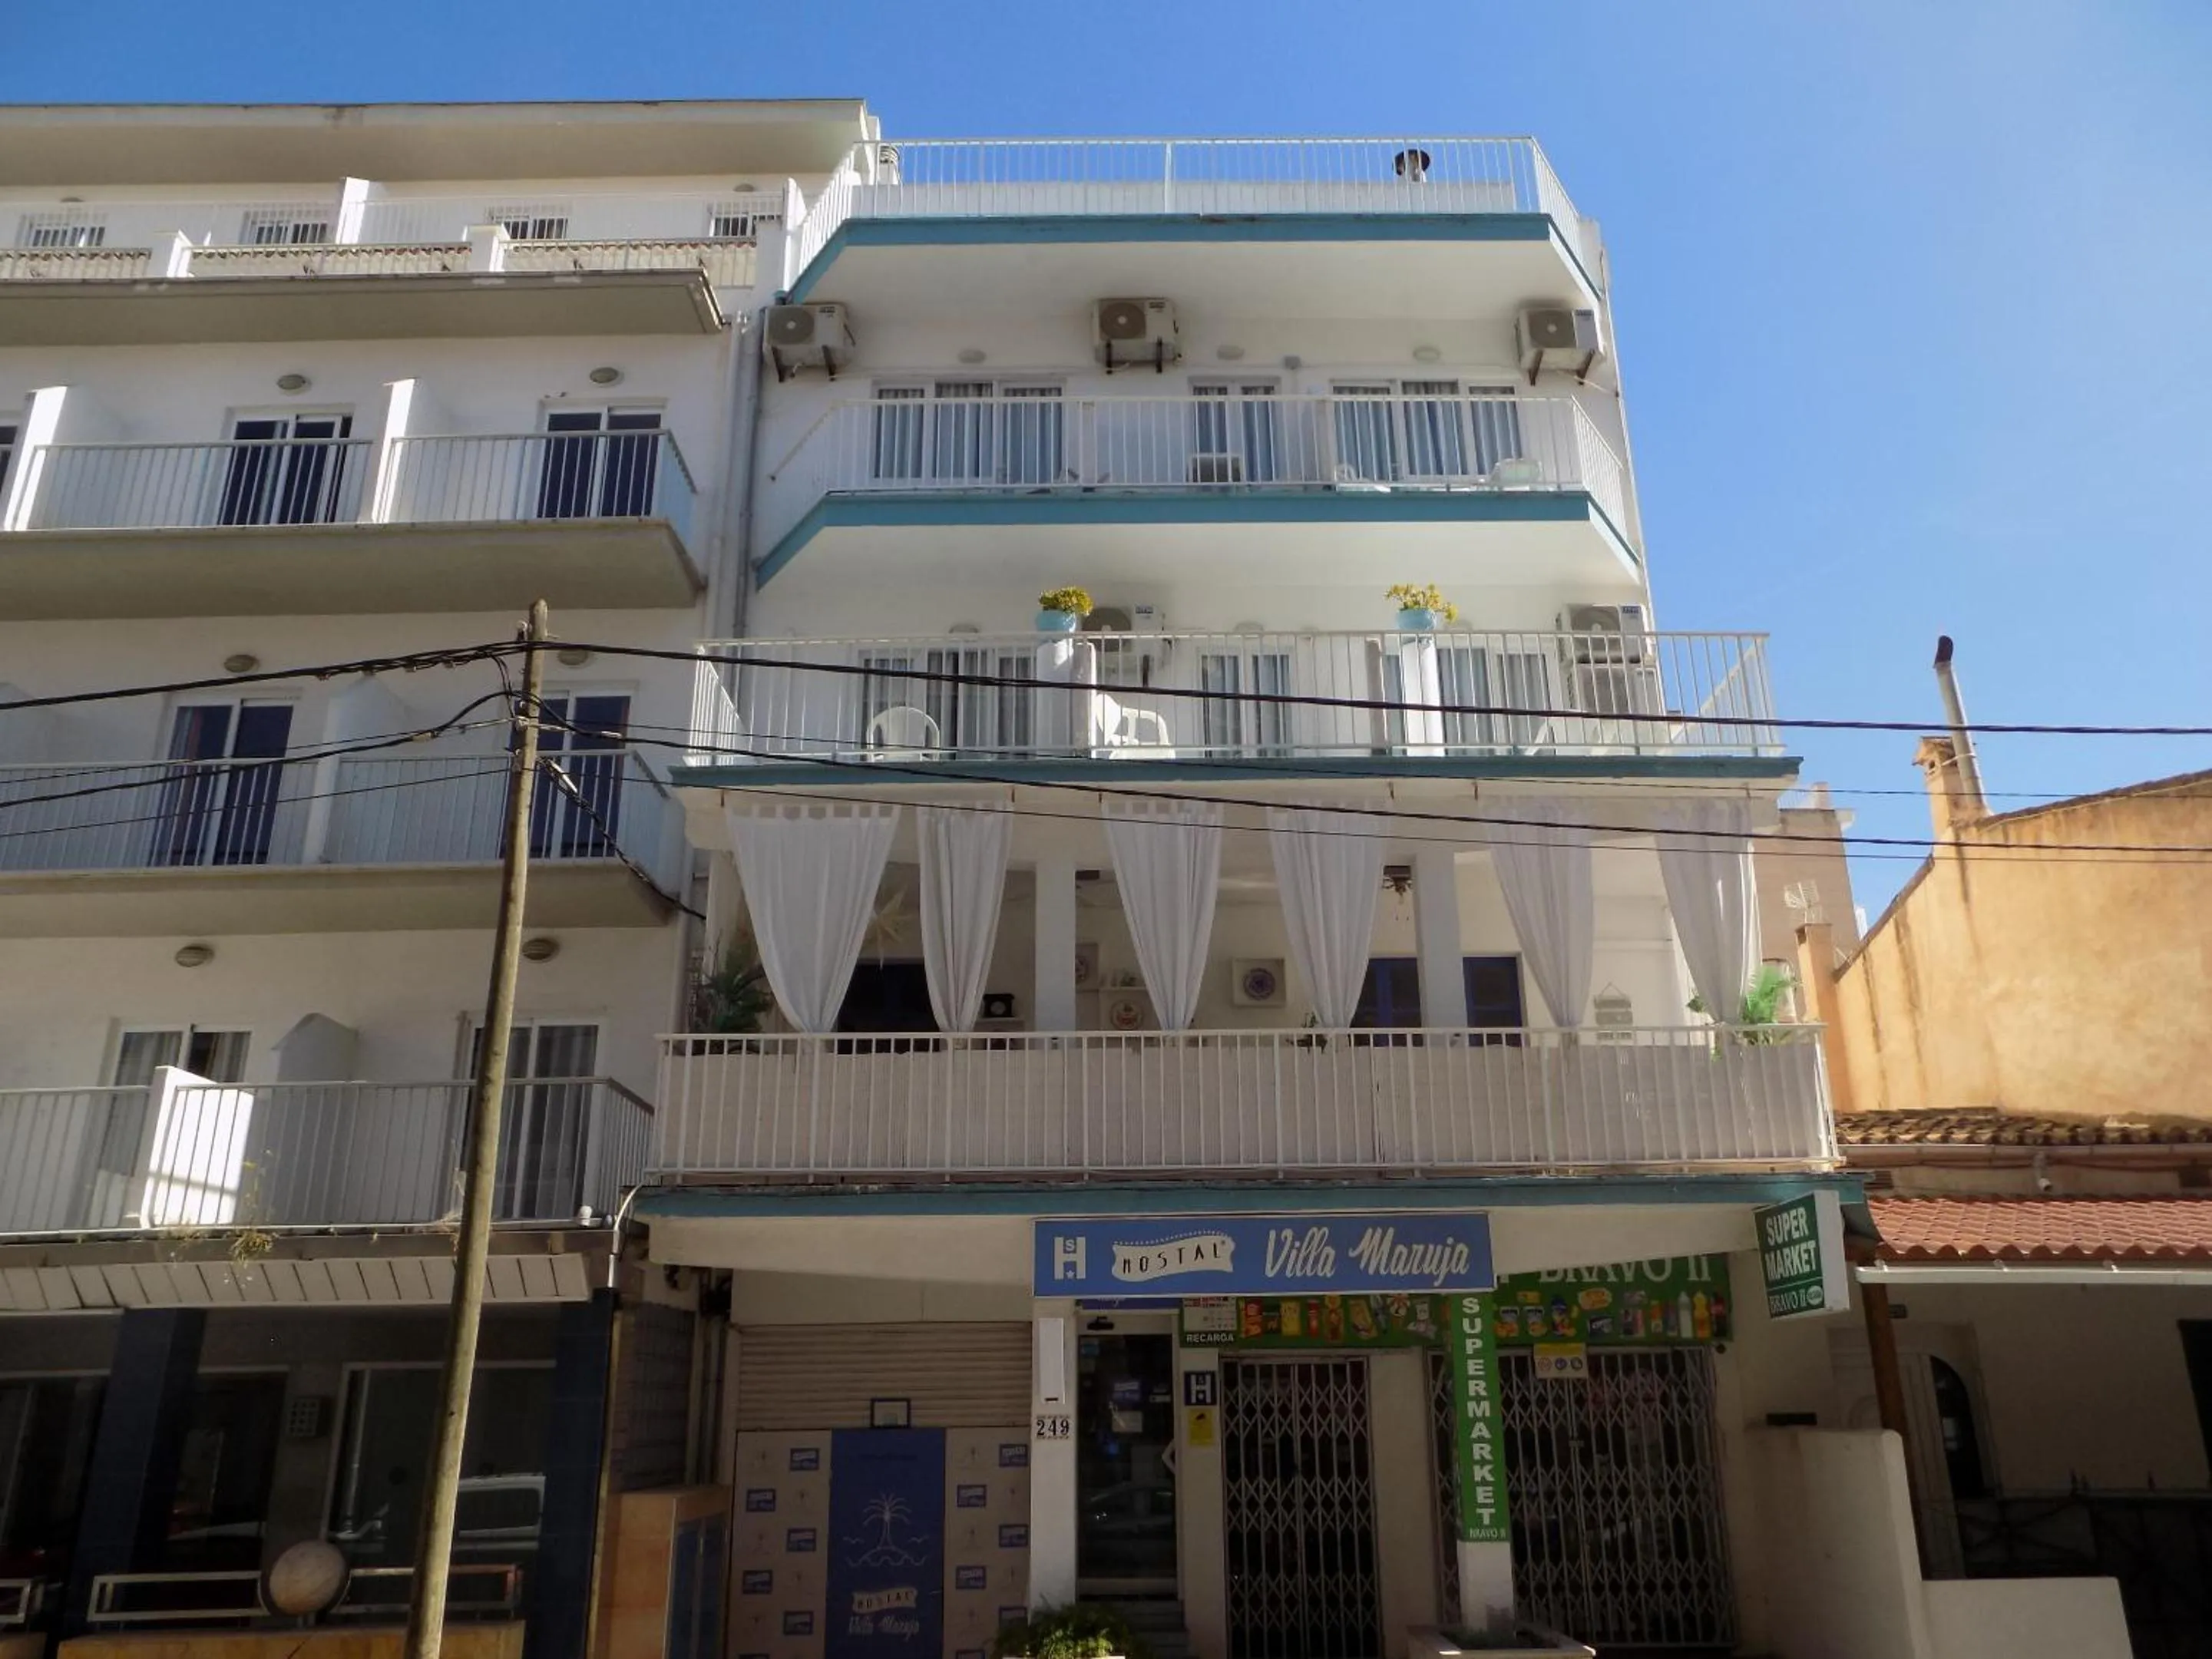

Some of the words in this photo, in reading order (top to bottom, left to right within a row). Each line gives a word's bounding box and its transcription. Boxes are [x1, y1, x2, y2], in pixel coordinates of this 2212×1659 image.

[1766, 1207, 1809, 1247] SUPER
[1123, 1242, 1222, 1274] HOSTAL
[1265, 1227, 1336, 1278] Villa
[1348, 1227, 1470, 1287] Maruja
[1765, 1240, 1817, 1281] MARKET
[1769, 1291, 1798, 1314] BRAVO
[1186, 1332, 1235, 1343] RECARGA
[1037, 1419, 1070, 1436] 249
[1462, 1297, 1496, 1525] SUPERMARKET
